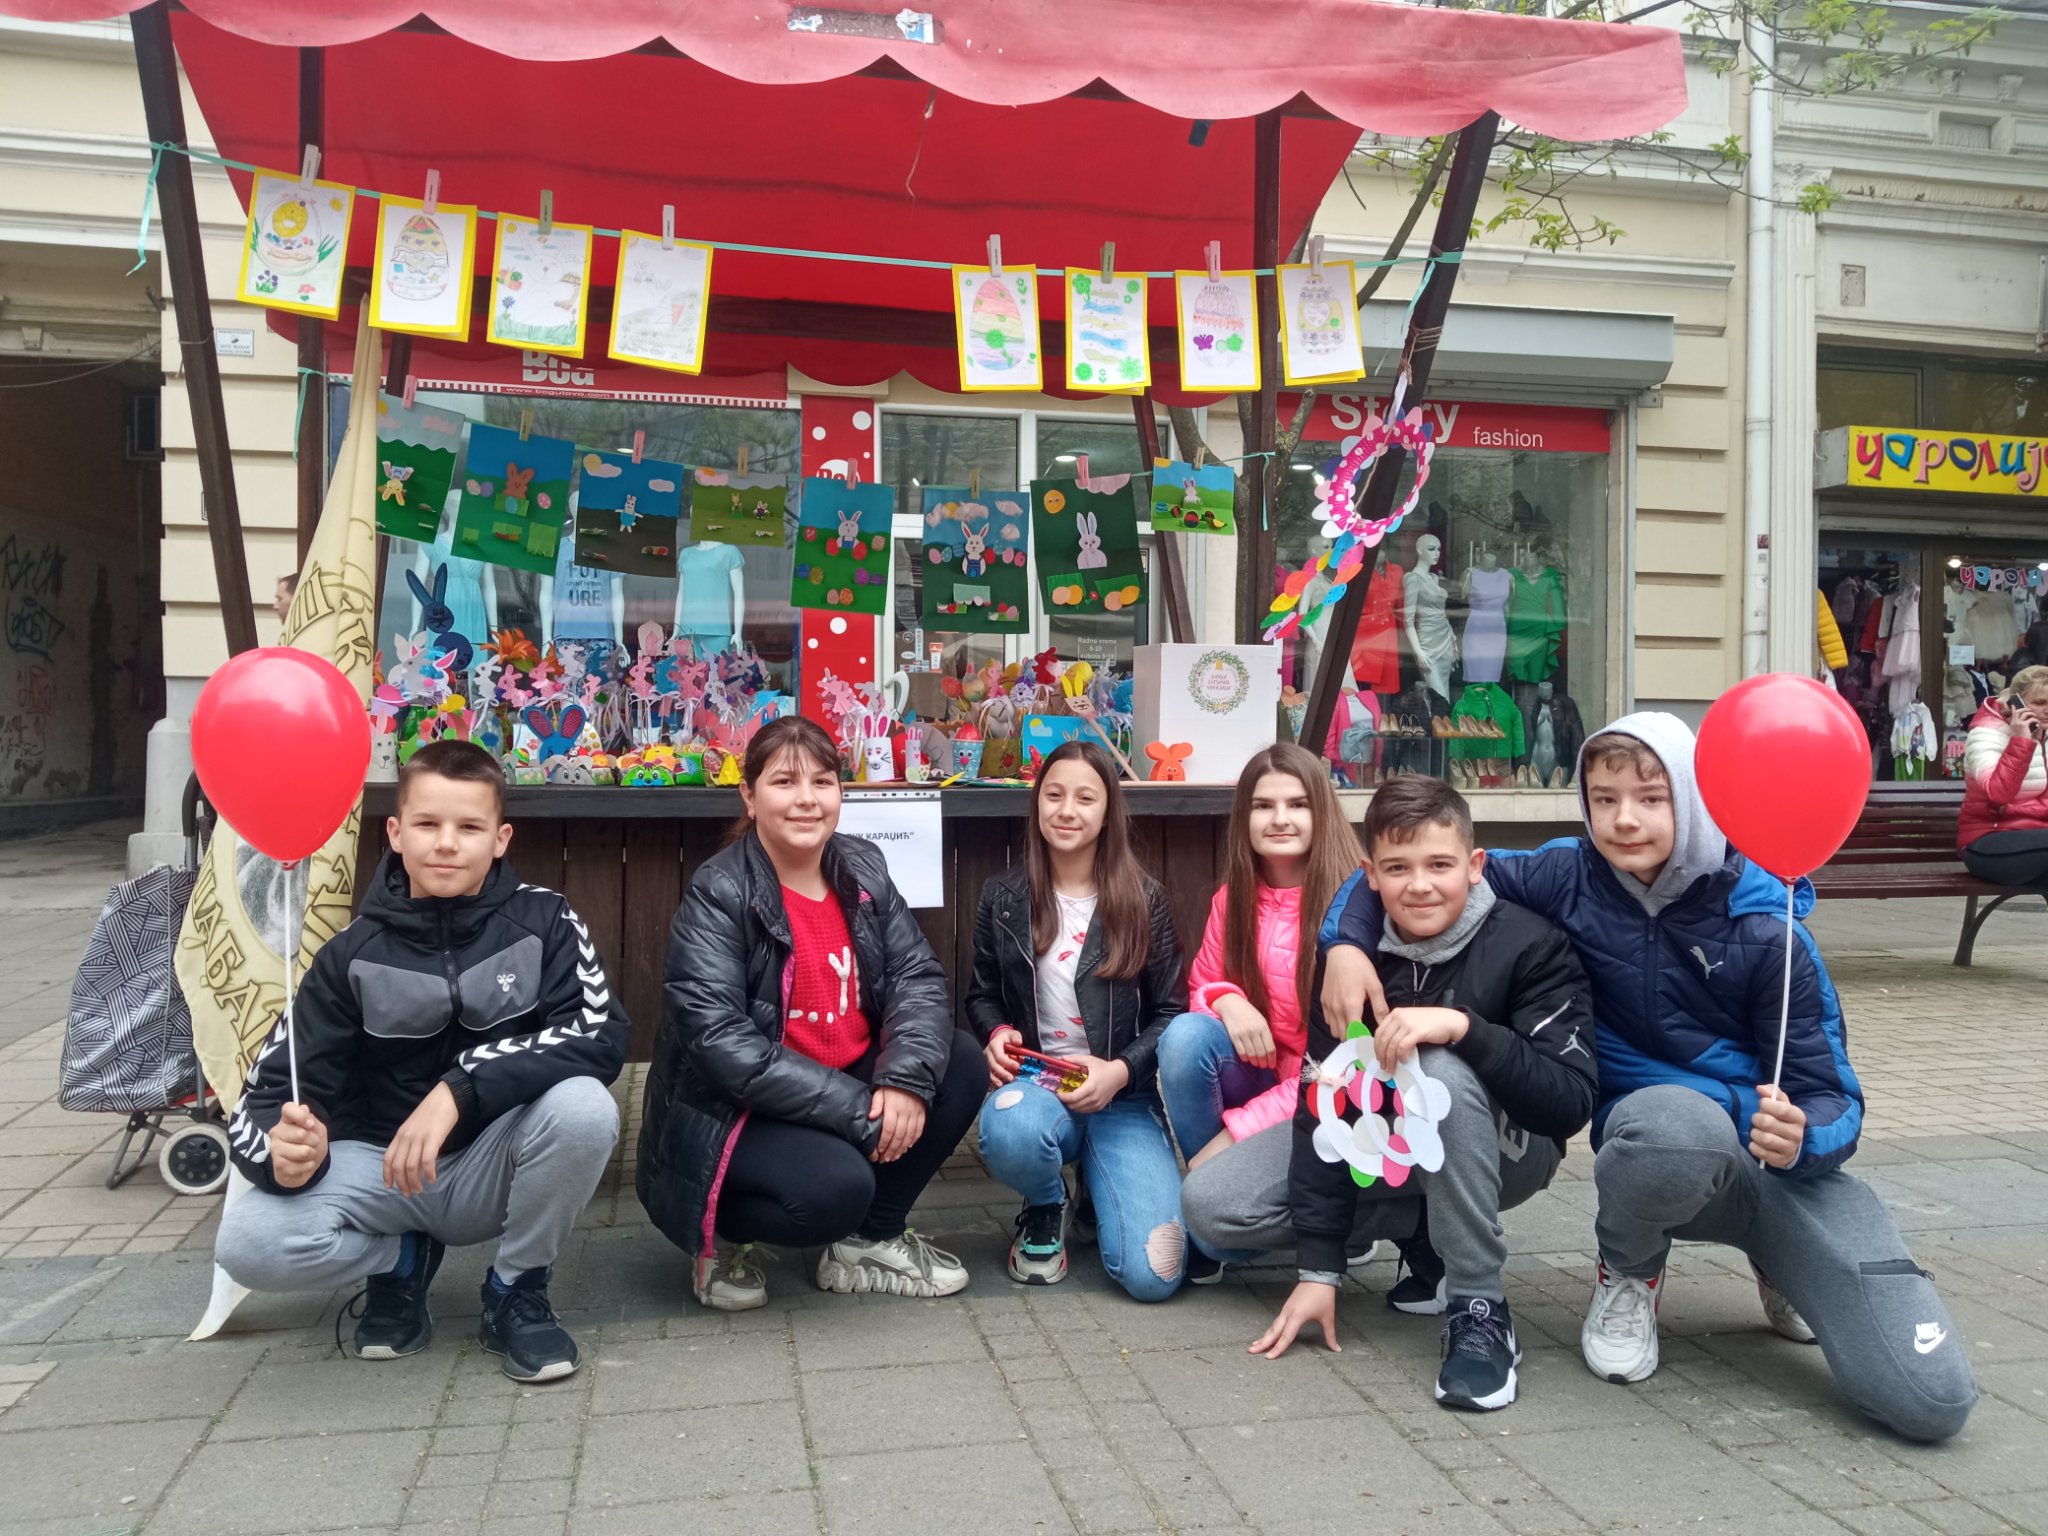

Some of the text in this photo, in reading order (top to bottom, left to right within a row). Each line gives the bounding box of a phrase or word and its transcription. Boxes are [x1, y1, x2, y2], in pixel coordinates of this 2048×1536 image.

[1331, 393, 1460, 443] Sty
[1473, 427, 1543, 448] fashion
[1856, 433, 2048, 493] чаролиј
[569, 590, 603, 607] URE
